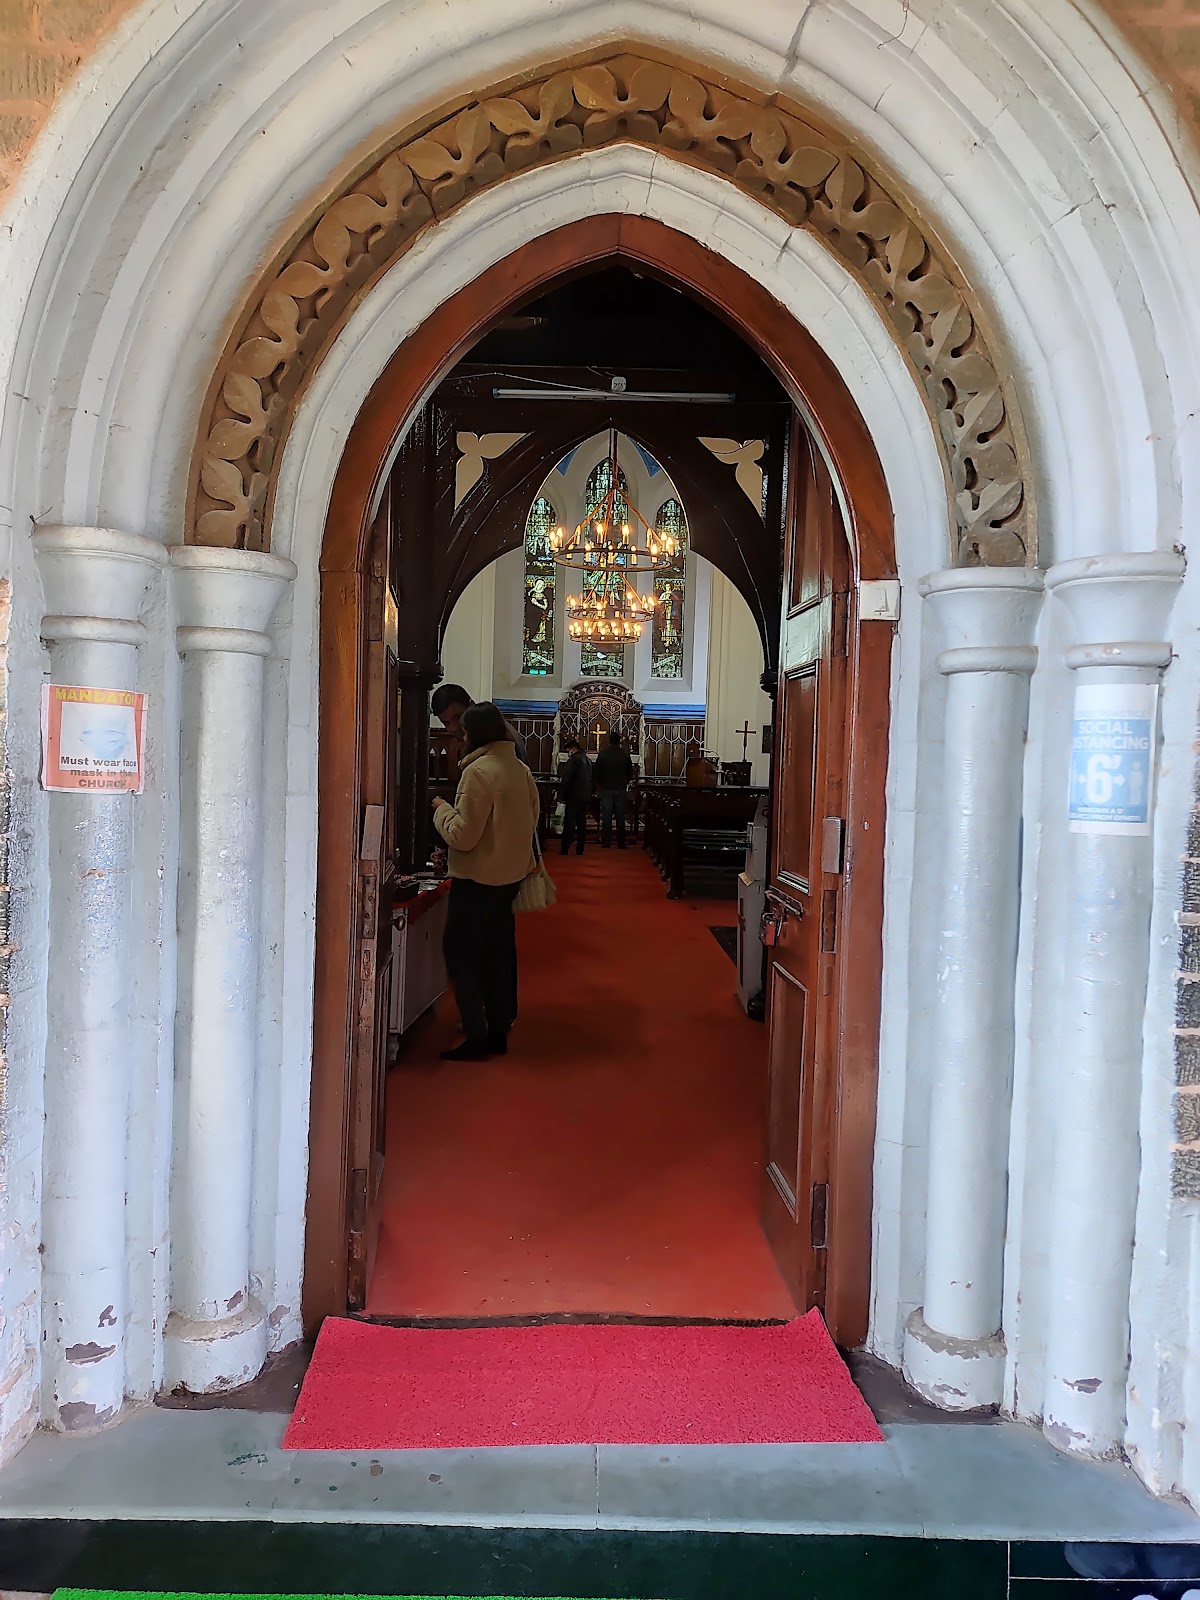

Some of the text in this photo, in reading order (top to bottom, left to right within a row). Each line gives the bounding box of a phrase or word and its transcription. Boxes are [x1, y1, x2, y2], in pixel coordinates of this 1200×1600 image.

[1079, 721, 1133, 734] SOCIAL
[60, 756, 89, 766] Must
[122, 759, 137, 767] face
[70, 769, 103, 777] mask
[79, 779, 127, 788] CHURCH
